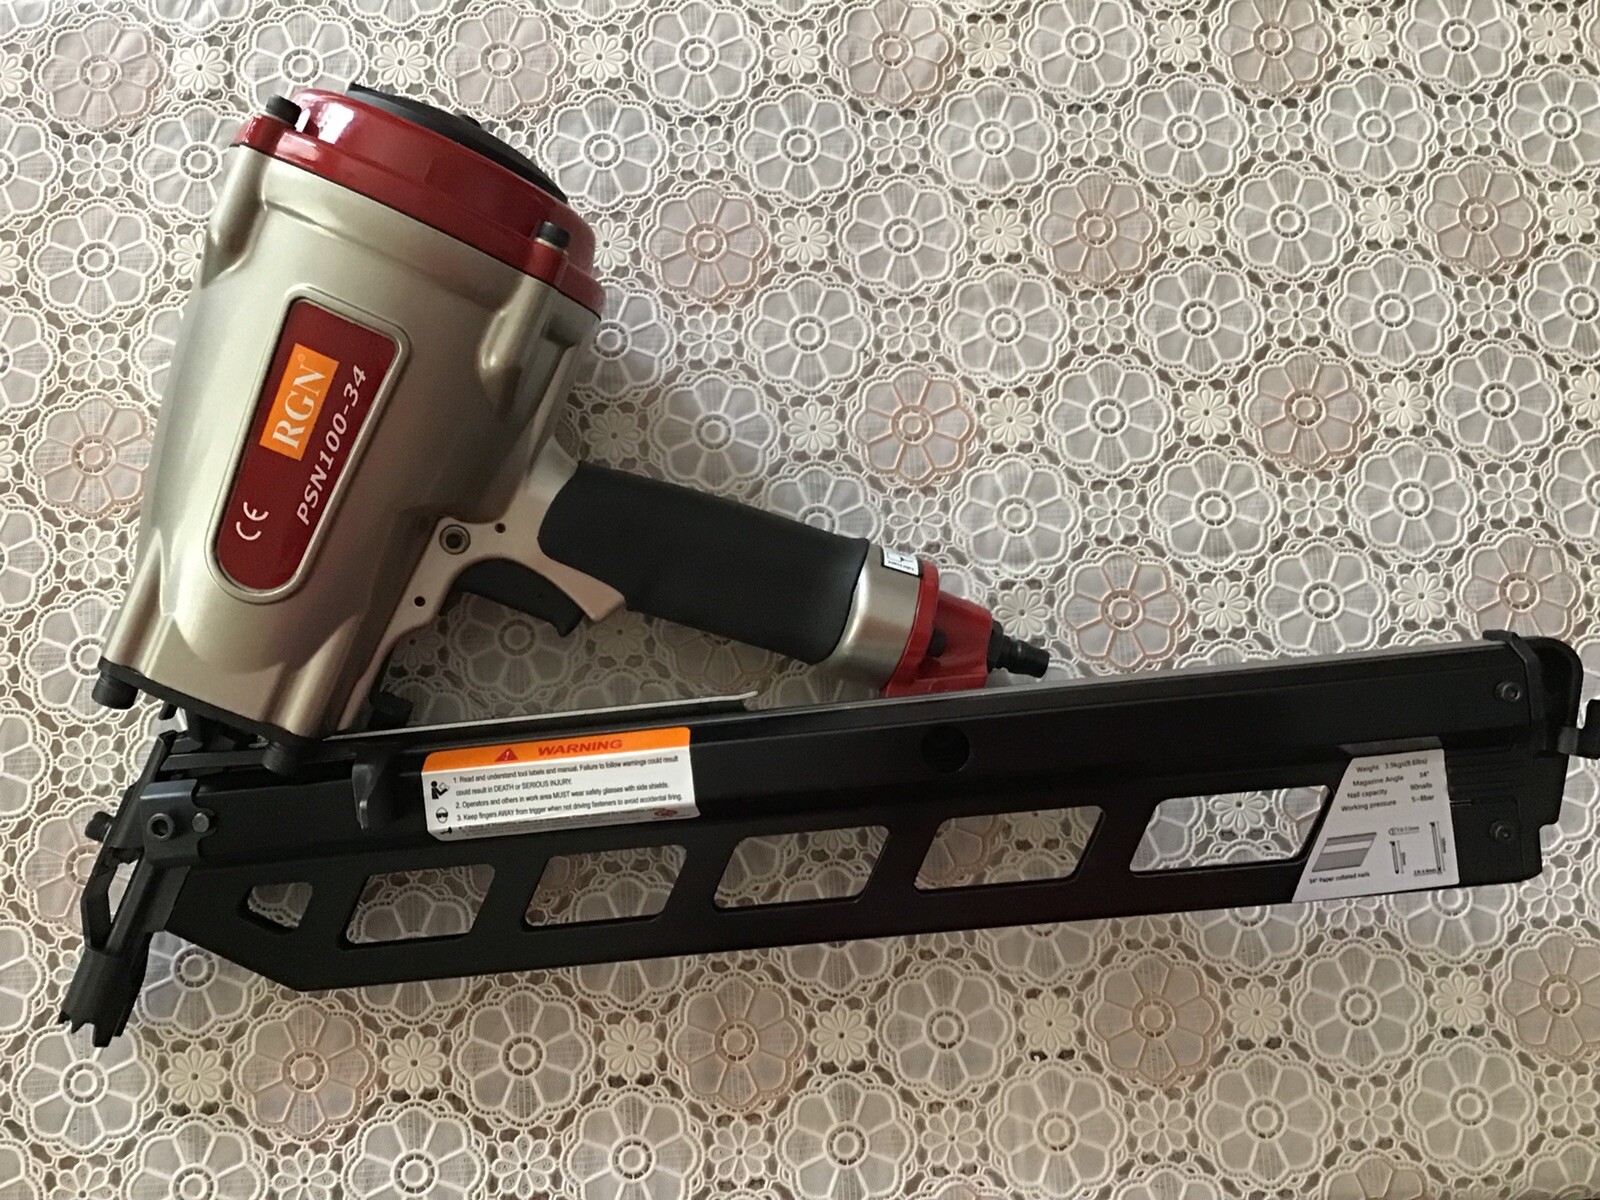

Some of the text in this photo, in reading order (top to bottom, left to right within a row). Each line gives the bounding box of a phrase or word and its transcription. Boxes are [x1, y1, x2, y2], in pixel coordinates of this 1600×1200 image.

[271, 365, 326, 450] RGN
[296, 364, 367, 526] PSN100-34
[235, 501, 269, 541] CE
[537, 739, 623, 757] WARNING
[459, 775, 474, 783] Read
[487, 771, 517, 780] understand
[528, 768, 545, 776] labels
[579, 763, 598, 771] Failure
[622, 759, 647, 767] warnings
[662, 755, 678, 763] result
[1355, 764, 1379, 773] Weight
[456, 788, 471, 796] could
[471, 786, 487, 795] result
[493, 783, 514, 792] DEATH
[521, 780, 549, 790] SERIOUS
[1352, 777, 1384, 787] Magazine
[1385, 775, 1404, 783] Angle
[462, 799, 489, 809] Operators
[501, 796, 518, 804] others
[552, 790, 570, 799] MUST
[585, 788, 601, 796] safety
[602, 785, 623, 795] glasses
[624, 784, 635, 792] with
[636, 783, 648, 791] side
[1346, 791, 1360, 799] Nail
[1361, 788, 1388, 798] capacity
[463, 813, 478, 821] Keep
[479, 811, 497, 820] fingers
[497, 808, 514, 817] AWAY
[528, 805, 546, 815] trigger
[547, 804, 562, 812] when
[572, 802, 591, 810] driving
[591, 799, 616, 808] fasteners
[624, 797, 639, 805] avoid
[639, 794, 666, 803] accidental
[1340, 803, 1369, 812] Working
[1369, 800, 1397, 809] pressure
